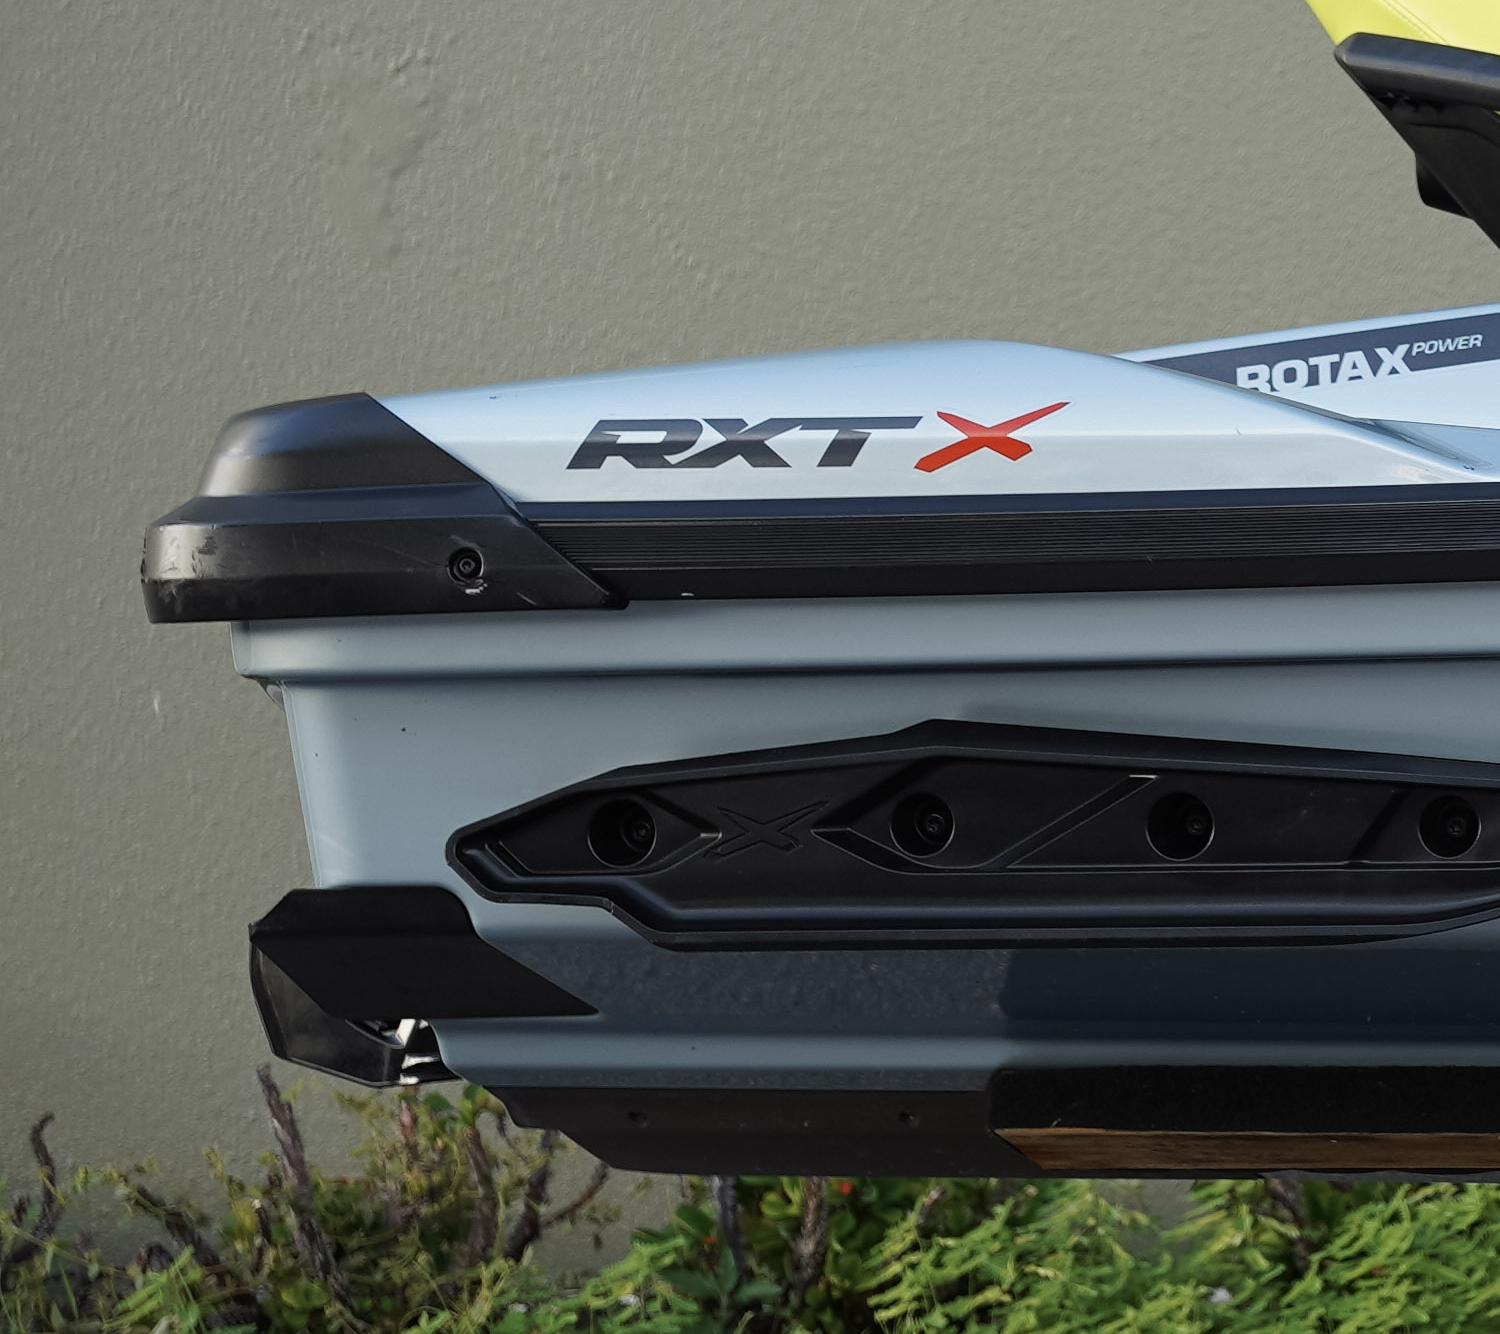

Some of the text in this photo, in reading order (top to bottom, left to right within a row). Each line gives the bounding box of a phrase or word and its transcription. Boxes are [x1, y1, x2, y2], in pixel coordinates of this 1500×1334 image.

[1236, 334, 1483, 393] ROTAX POWER
[565, 401, 1071, 473] RXT X
